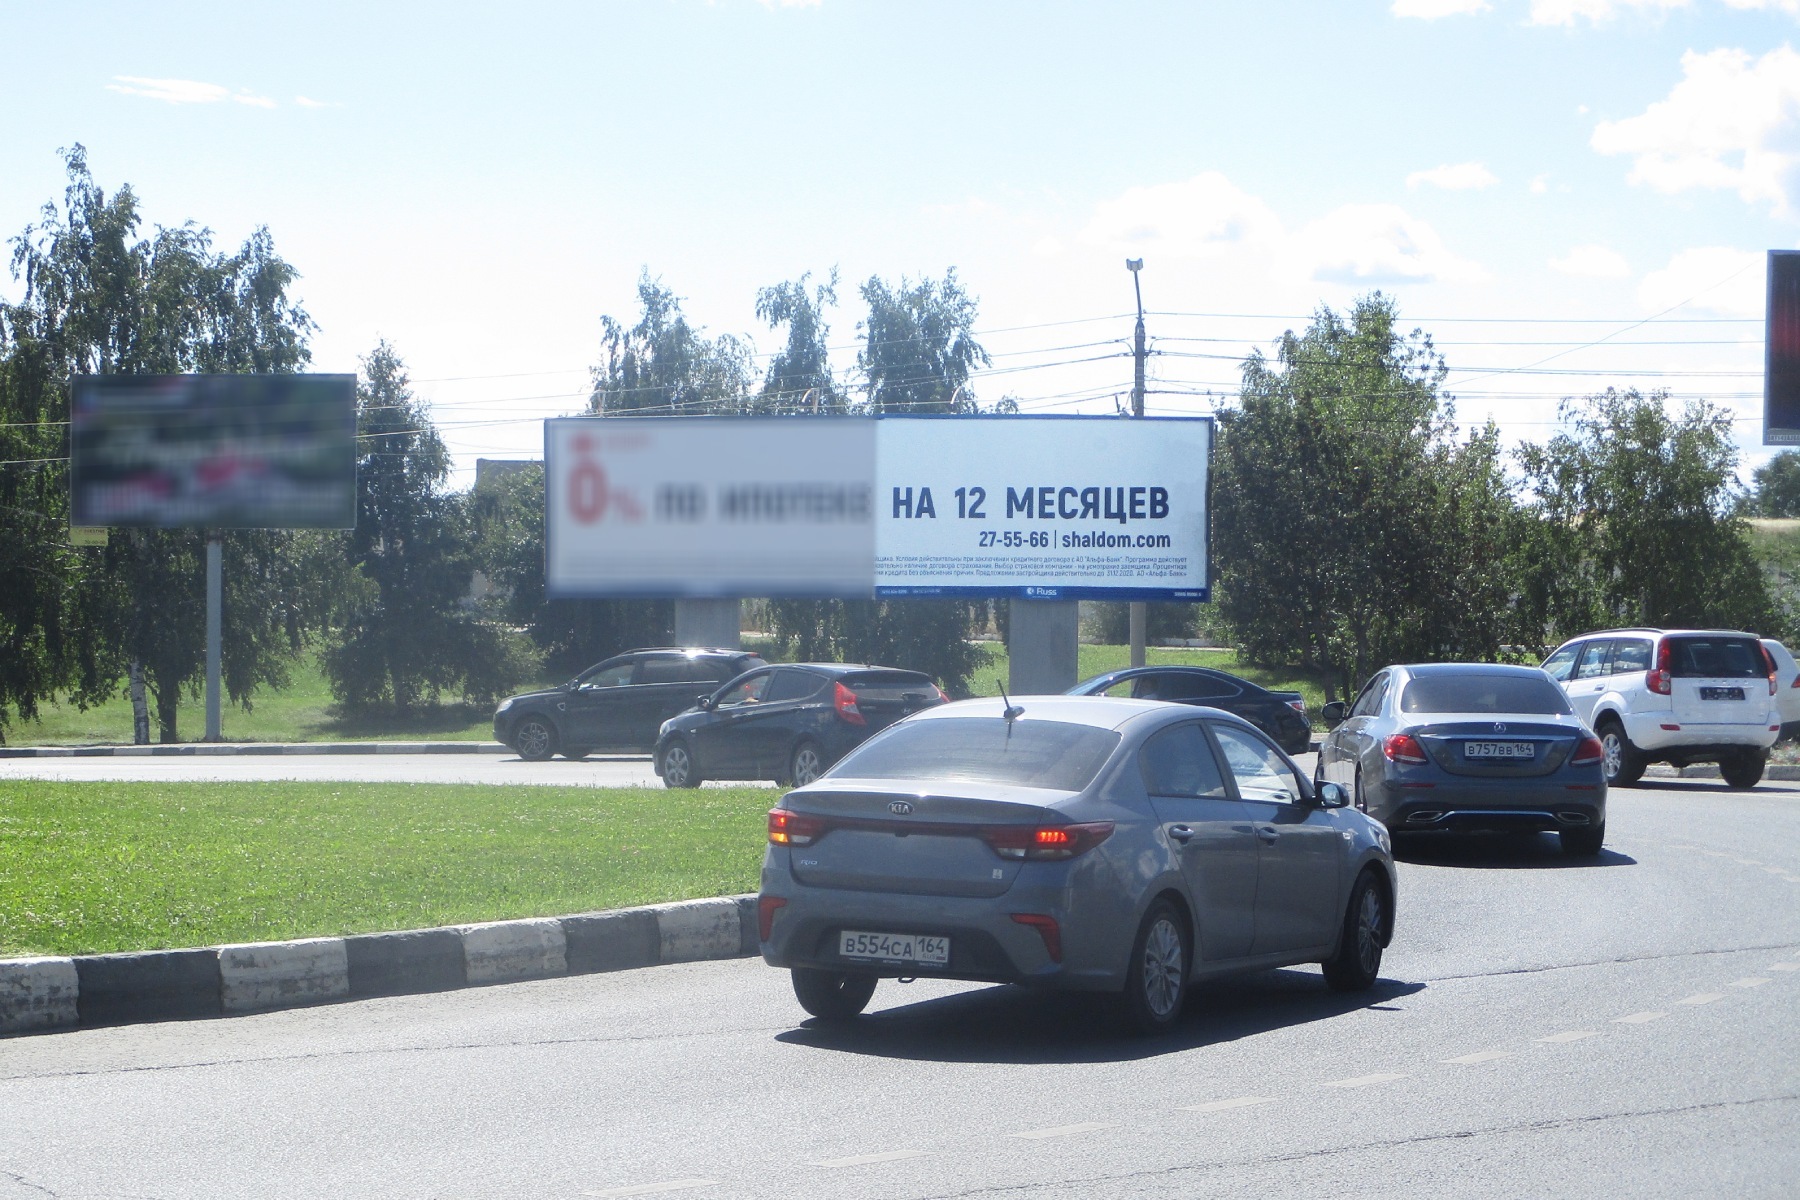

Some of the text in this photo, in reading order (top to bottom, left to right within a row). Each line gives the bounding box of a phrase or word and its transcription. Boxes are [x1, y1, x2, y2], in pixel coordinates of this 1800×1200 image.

[893, 486, 936, 519] НА
[954, 486, 986, 519] 12
[1006, 486, 1170, 524] МЕСЯЦЕВ
[979, 530, 1171, 548] 27-55-66 shaldom.com
[1036, 588, 1057, 596] Russ
[1514, 744, 1531, 752] 164
[891, 803, 910, 814] KIA
[918, 938, 944, 954] 164
